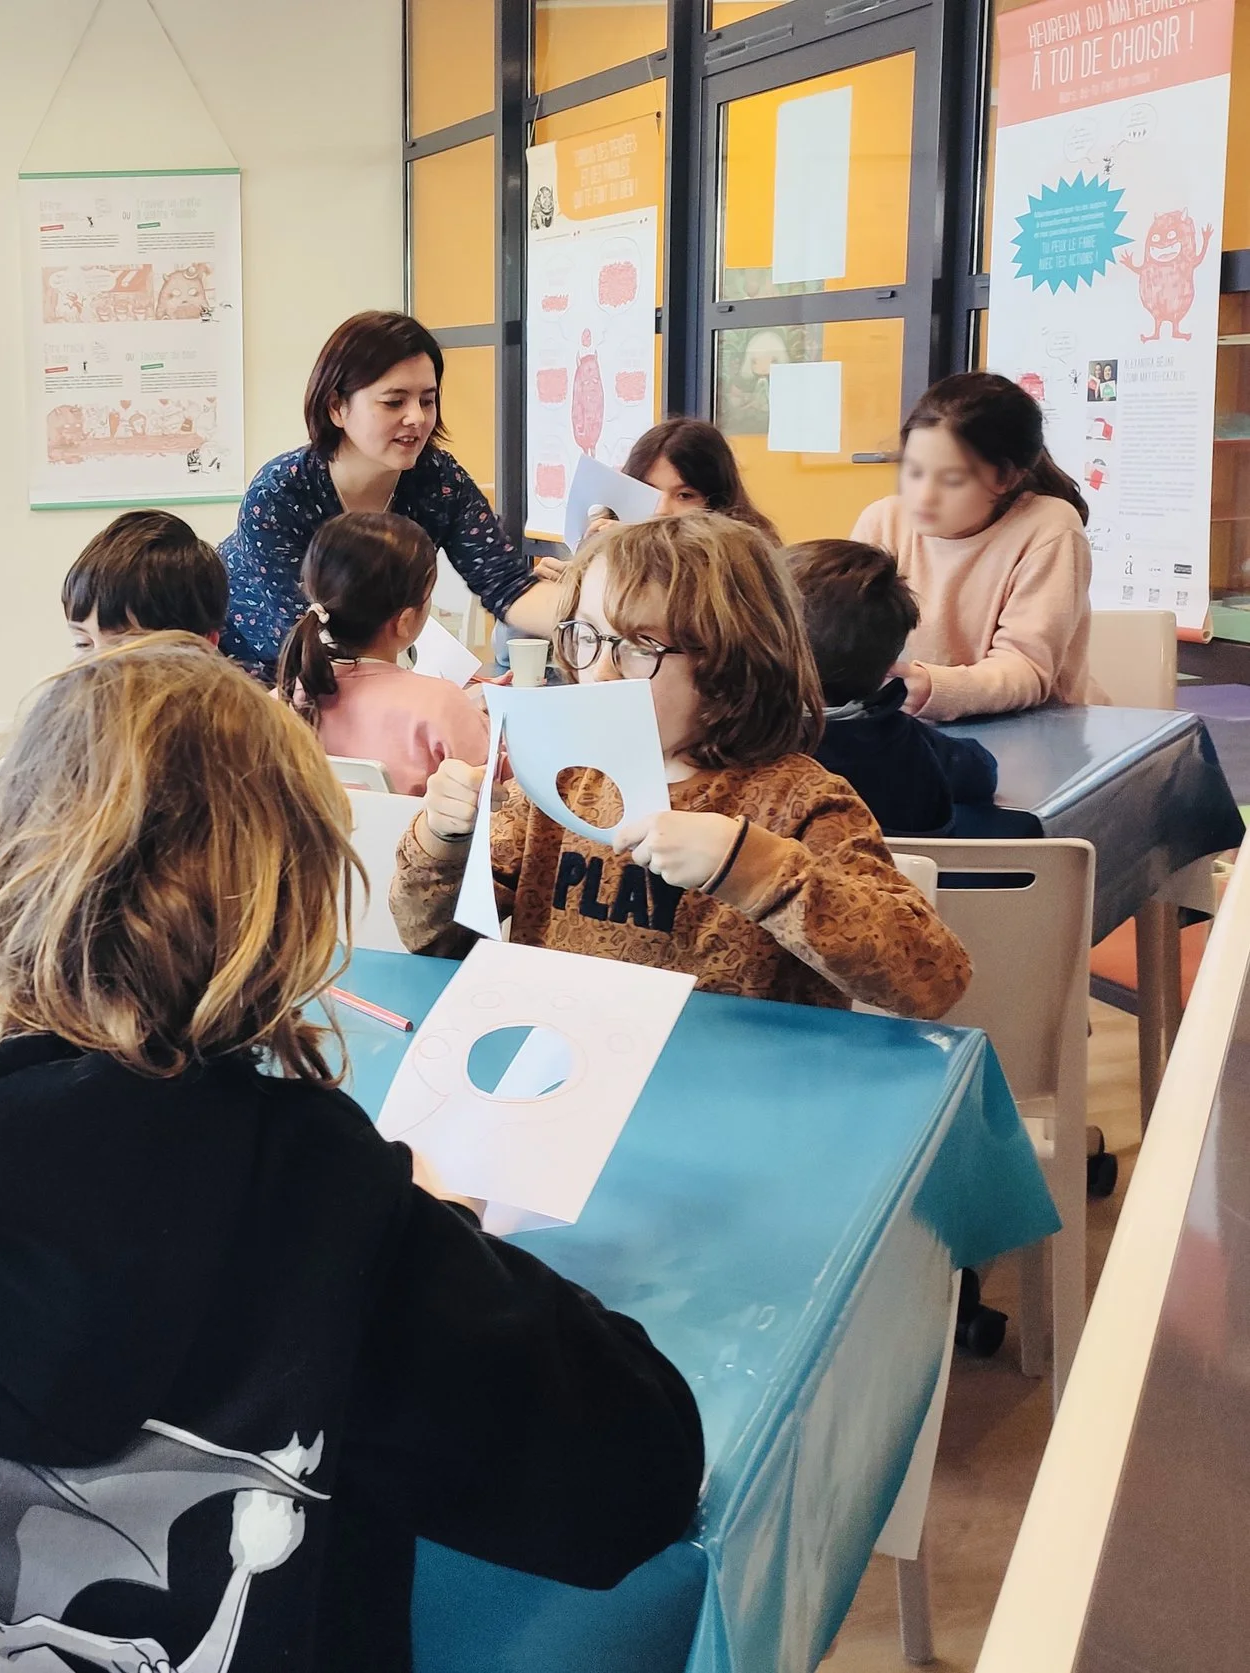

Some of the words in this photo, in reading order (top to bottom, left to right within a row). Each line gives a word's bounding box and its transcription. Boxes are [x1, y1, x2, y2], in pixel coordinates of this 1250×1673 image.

[1028, 10, 1082, 49] HEUREUX
[1085, 5, 1103, 33] OU
[1050, 46, 1074, 86] TOI
[1081, 36, 1103, 79] DE
[1111, 15, 1181, 70] CHOISIR
[1189, 10, 1195, 49] !
[553, 851, 686, 933] PLAY
